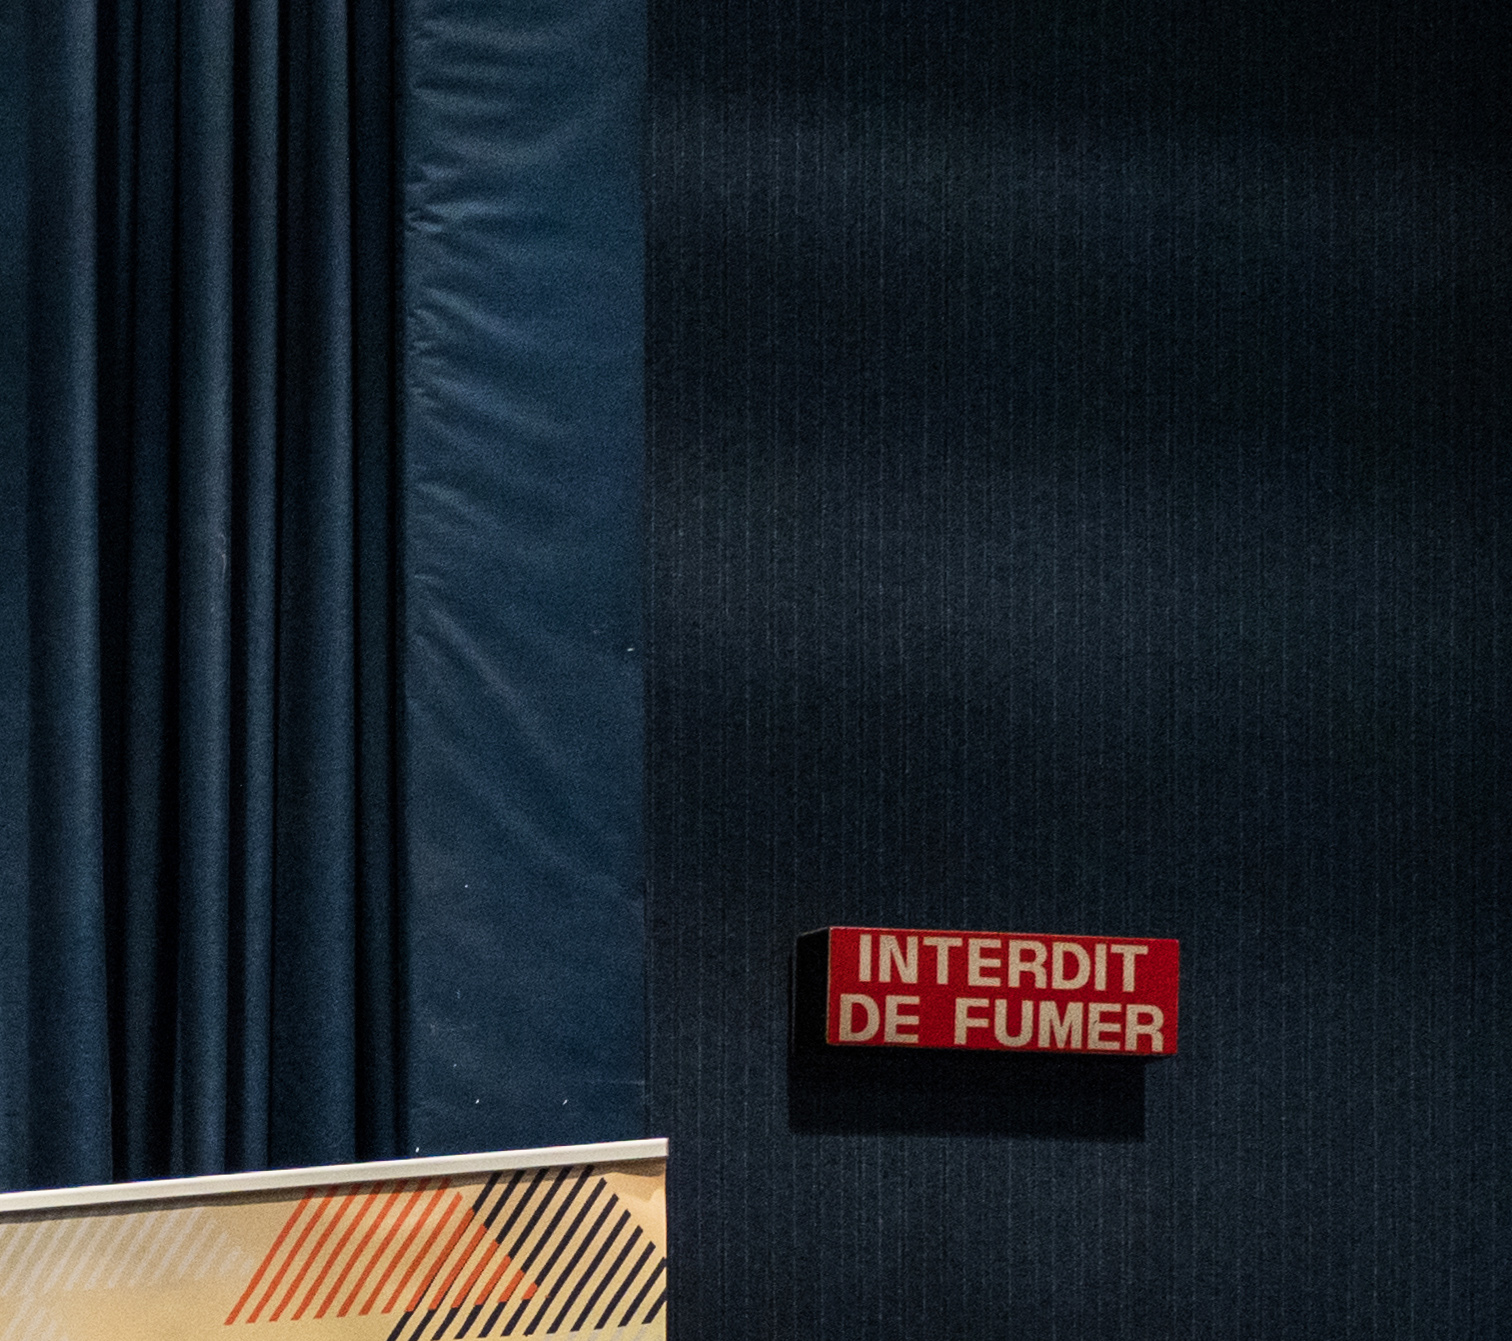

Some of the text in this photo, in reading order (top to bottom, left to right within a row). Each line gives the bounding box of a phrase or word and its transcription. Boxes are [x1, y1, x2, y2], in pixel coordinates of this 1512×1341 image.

[859, 934, 1149, 992] INTERDIT
[838, 993, 1164, 1053] DE FUMER
